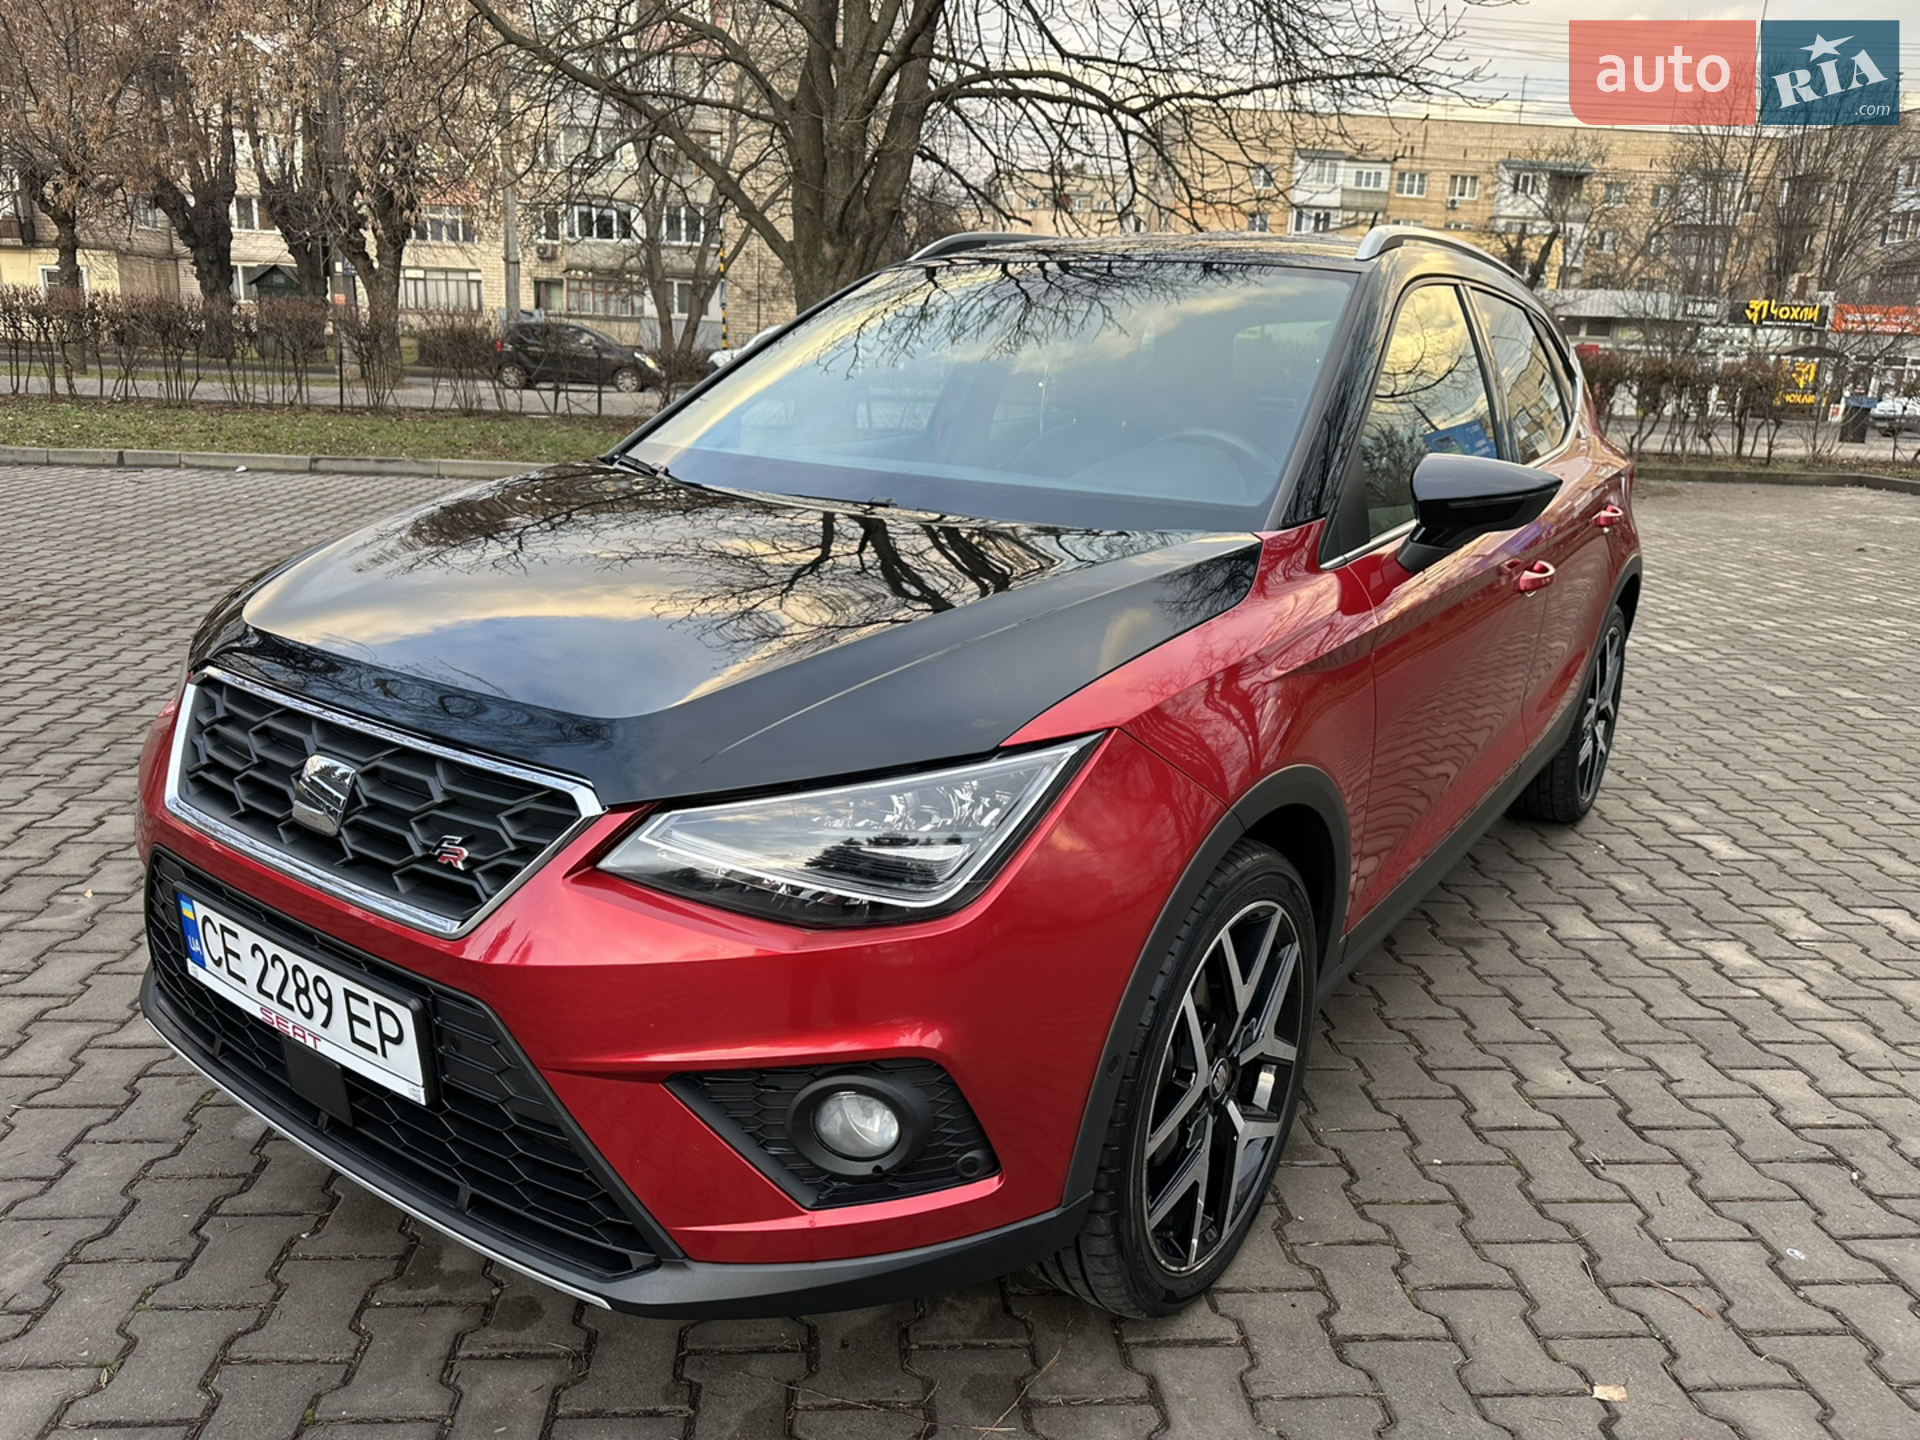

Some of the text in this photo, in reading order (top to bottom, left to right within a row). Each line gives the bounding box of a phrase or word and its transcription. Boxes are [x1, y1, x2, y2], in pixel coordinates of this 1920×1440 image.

[187, 936, 203, 956] UA
[200, 915, 405, 1059] CE 2289 EP
[259, 1006, 322, 1050] SEAT
